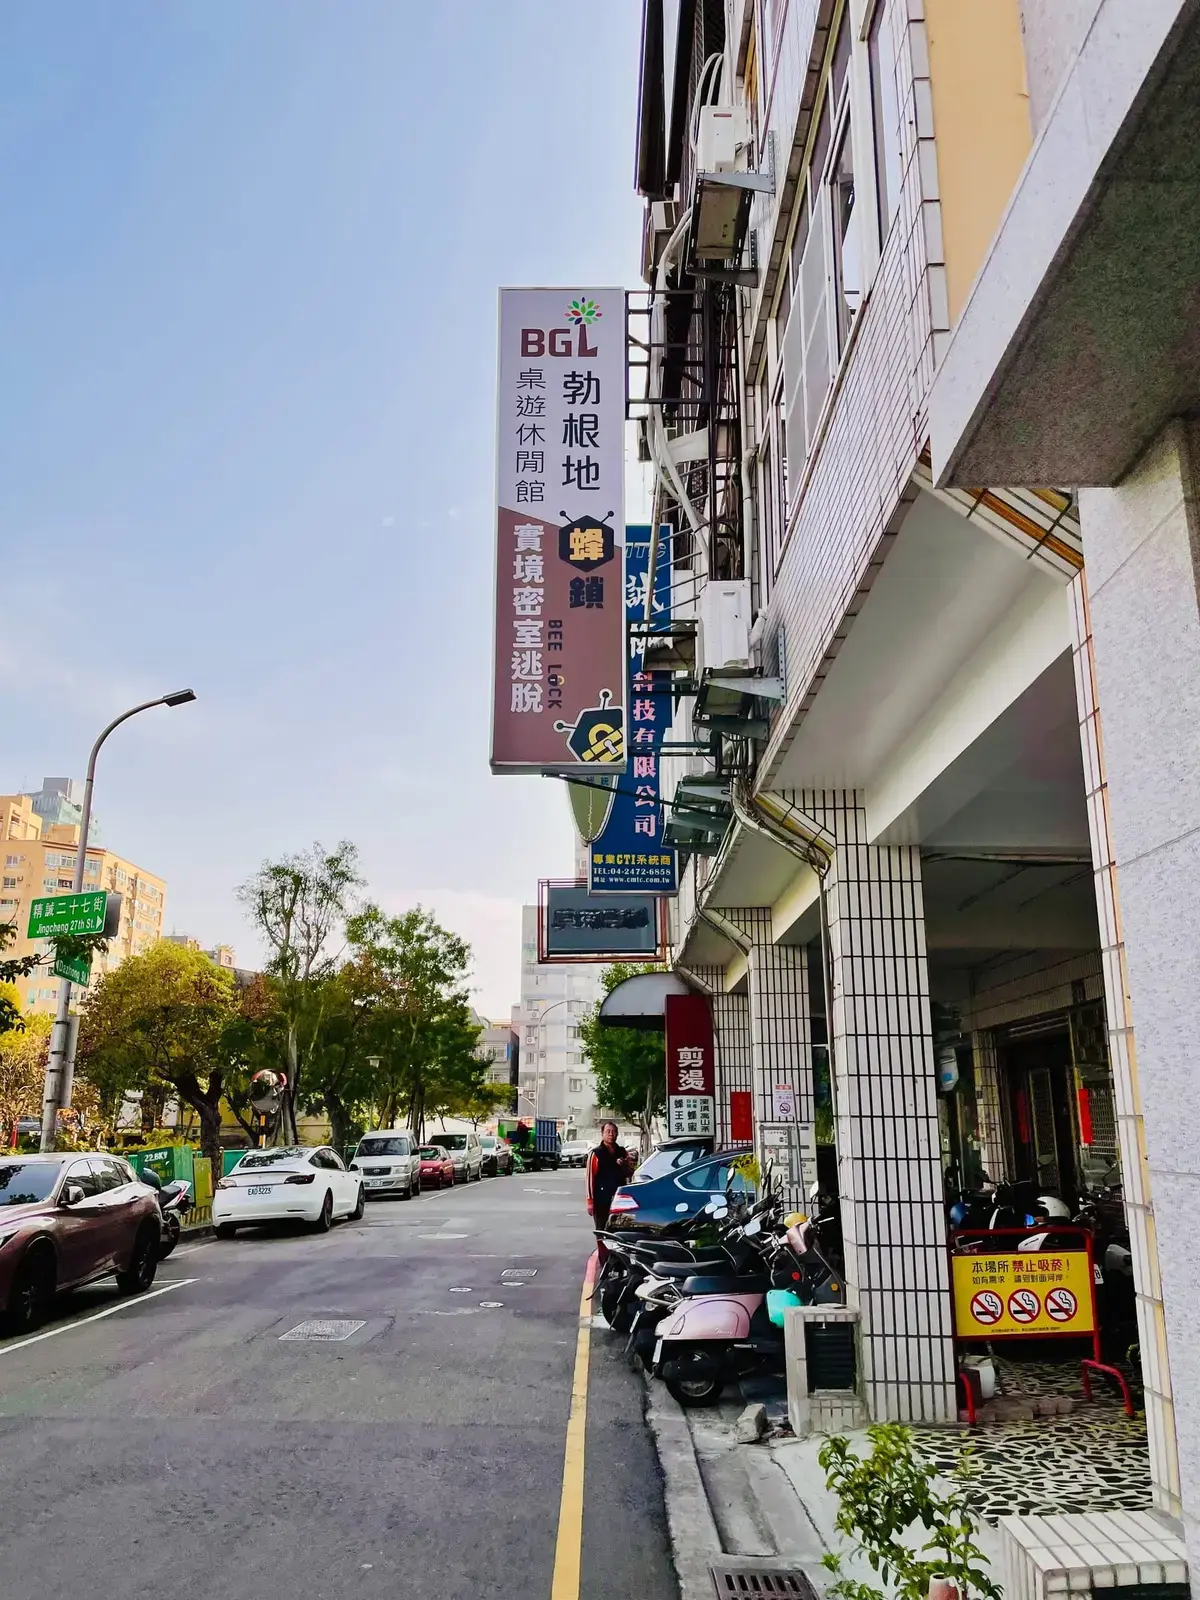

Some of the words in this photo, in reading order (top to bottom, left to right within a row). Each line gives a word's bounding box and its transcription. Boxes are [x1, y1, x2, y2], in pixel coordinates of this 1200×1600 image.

[520, 324, 598, 358] BGL
[515, 367, 546, 503] 桌遊休閒館
[561, 370, 600, 490] 勃根地
[511, 523, 544, 713] 實境密室逃脫
[548, 619, 562, 651] BEE
[547, 664, 564, 709] LOCK
[33, 896, 104, 919] 精誠二十七街
[36, 923, 69, 935] Jingcheng
[70, 920, 85, 931] 27th
[86, 918, 95, 929] St.
[677, 1046, 706, 1091] 剪燙
